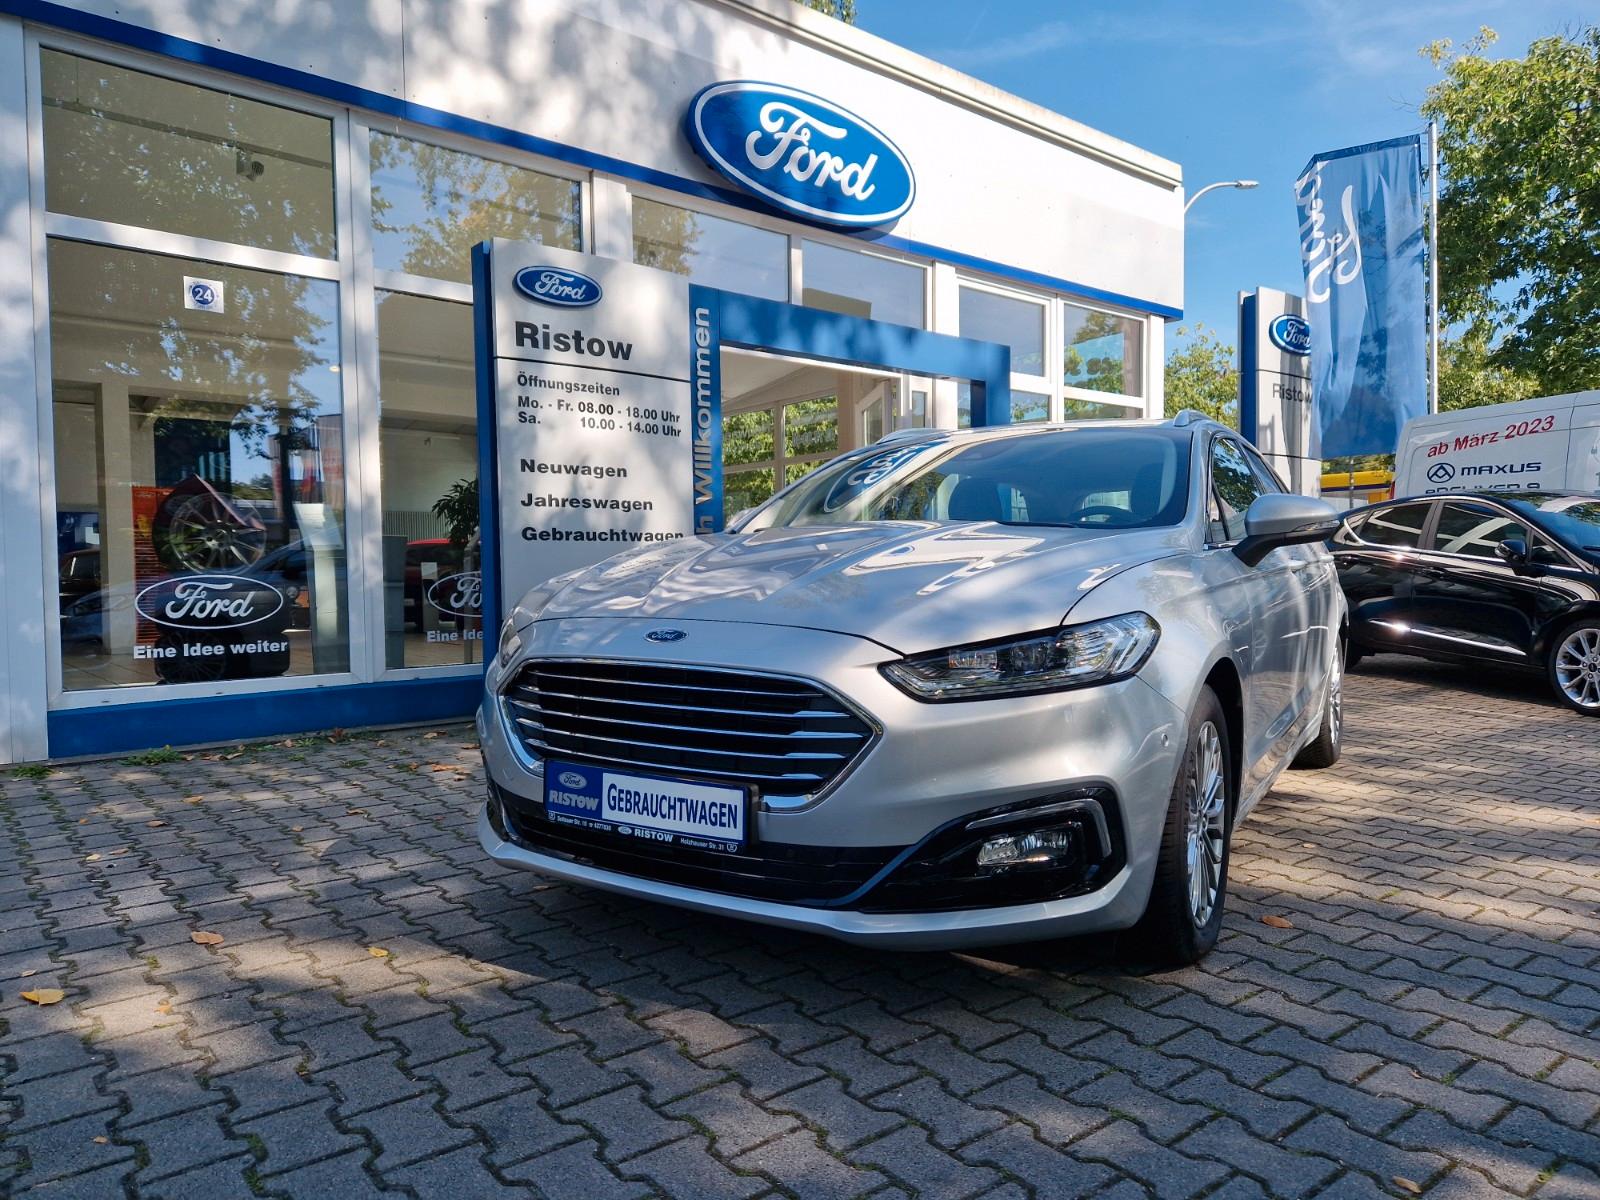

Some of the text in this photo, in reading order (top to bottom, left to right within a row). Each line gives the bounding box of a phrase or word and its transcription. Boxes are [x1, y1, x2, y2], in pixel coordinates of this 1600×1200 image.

[745, 101, 878, 201] Ford
[194, 287, 213, 302] 24
[534, 271, 587, 300] Ford
[515, 320, 633, 361] Ristow
[517, 371, 620, 397] Öffnungszeiten
[517, 395, 544, 409] Mo.
[557, 398, 574, 412] Fr.
[578, 401, 614, 416] 08.00
[626, 406, 658, 421] 18.00
[661, 410, 681, 424] Uhr
[694, 307, 714, 505] Willkommen
[518, 411, 542, 425] Sa.
[580, 416, 615, 431] 10.00
[627, 421, 659, 435] 14.00
[662, 425, 682, 438] Uhr
[1427, 415, 1555, 458] ab März 2023
[520, 458, 628, 478] Neuwagen
[1460, 462, 1542, 476] MAXUS
[520, 493, 653, 512] Jahreswagen
[521, 526, 684, 542] Gebrauchtwagen
[165, 581, 257, 619] Ford
[450, 576, 482, 608] Fo
[427, 628, 484, 643] Eine Ide
[133, 639, 288, 659] Eine Idee weiter
[549, 789, 599, 811] RISTOW
[607, 783, 737, 829] GEBRAUCHTWAGEN
[634, 828, 674, 843] RISTOW
